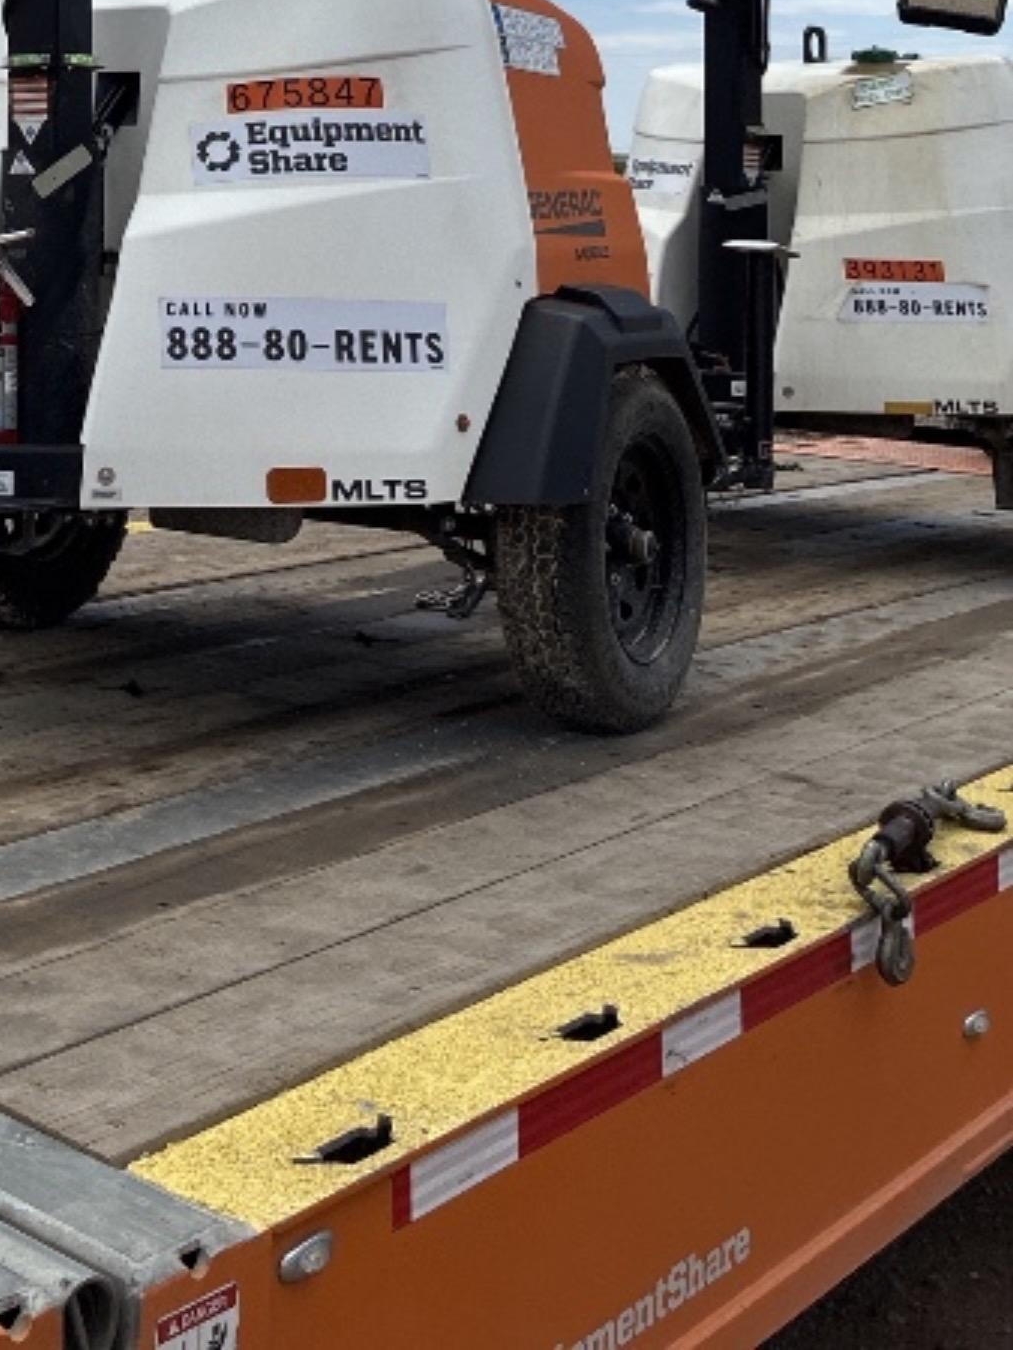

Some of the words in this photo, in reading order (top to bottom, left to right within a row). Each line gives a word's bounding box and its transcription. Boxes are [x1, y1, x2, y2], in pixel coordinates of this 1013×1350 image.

[230, 78, 379, 111] 675847
[245, 117, 425, 147] Equipment
[248, 150, 348, 175] Share
[166, 302, 214, 317] CALL
[224, 302, 268, 318] NOW
[166, 327, 445, 364] 888-80-RENTS
[331, 479, 428, 502] MLTS
